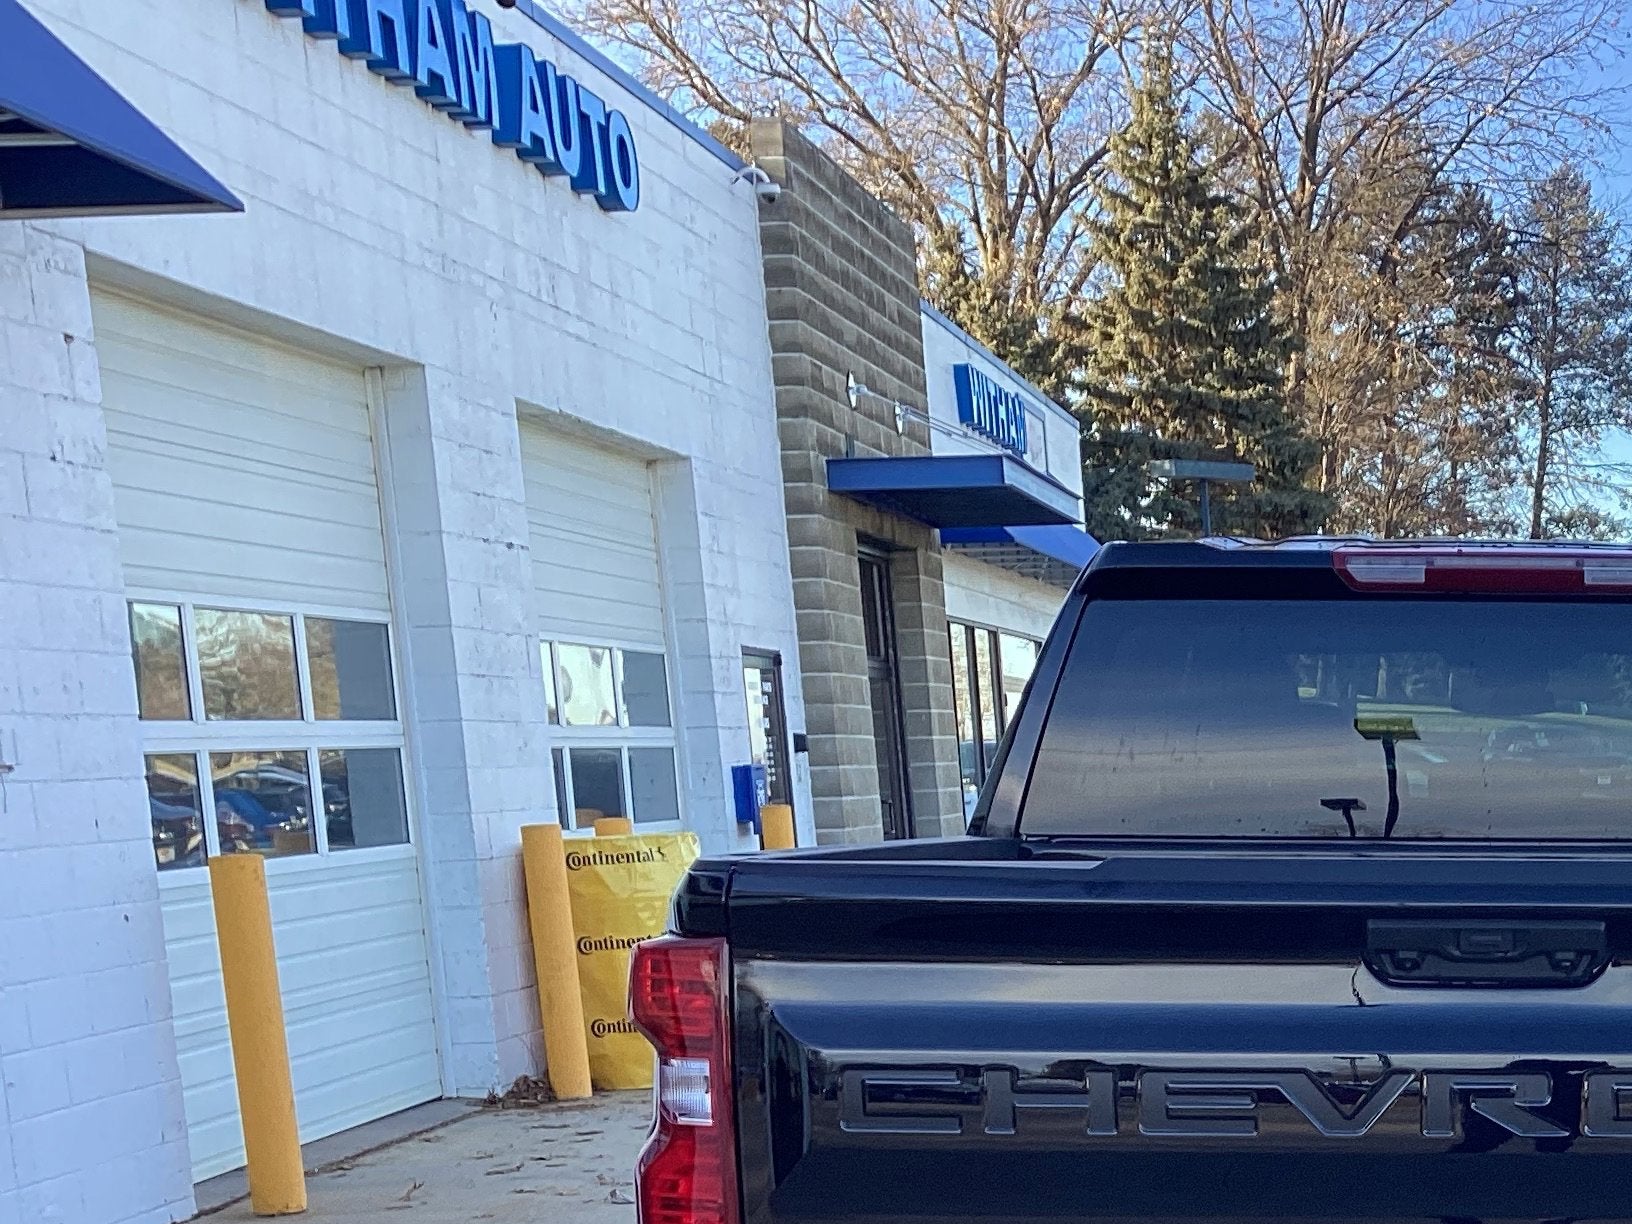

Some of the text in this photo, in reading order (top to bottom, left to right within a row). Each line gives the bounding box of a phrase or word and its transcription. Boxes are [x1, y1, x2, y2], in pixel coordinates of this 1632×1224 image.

[494, 42, 640, 213] AUTO
[954, 363, 1027, 455] WITHAM
[566, 847, 655, 871] Continental
[591, 1018, 638, 1038] Contin
